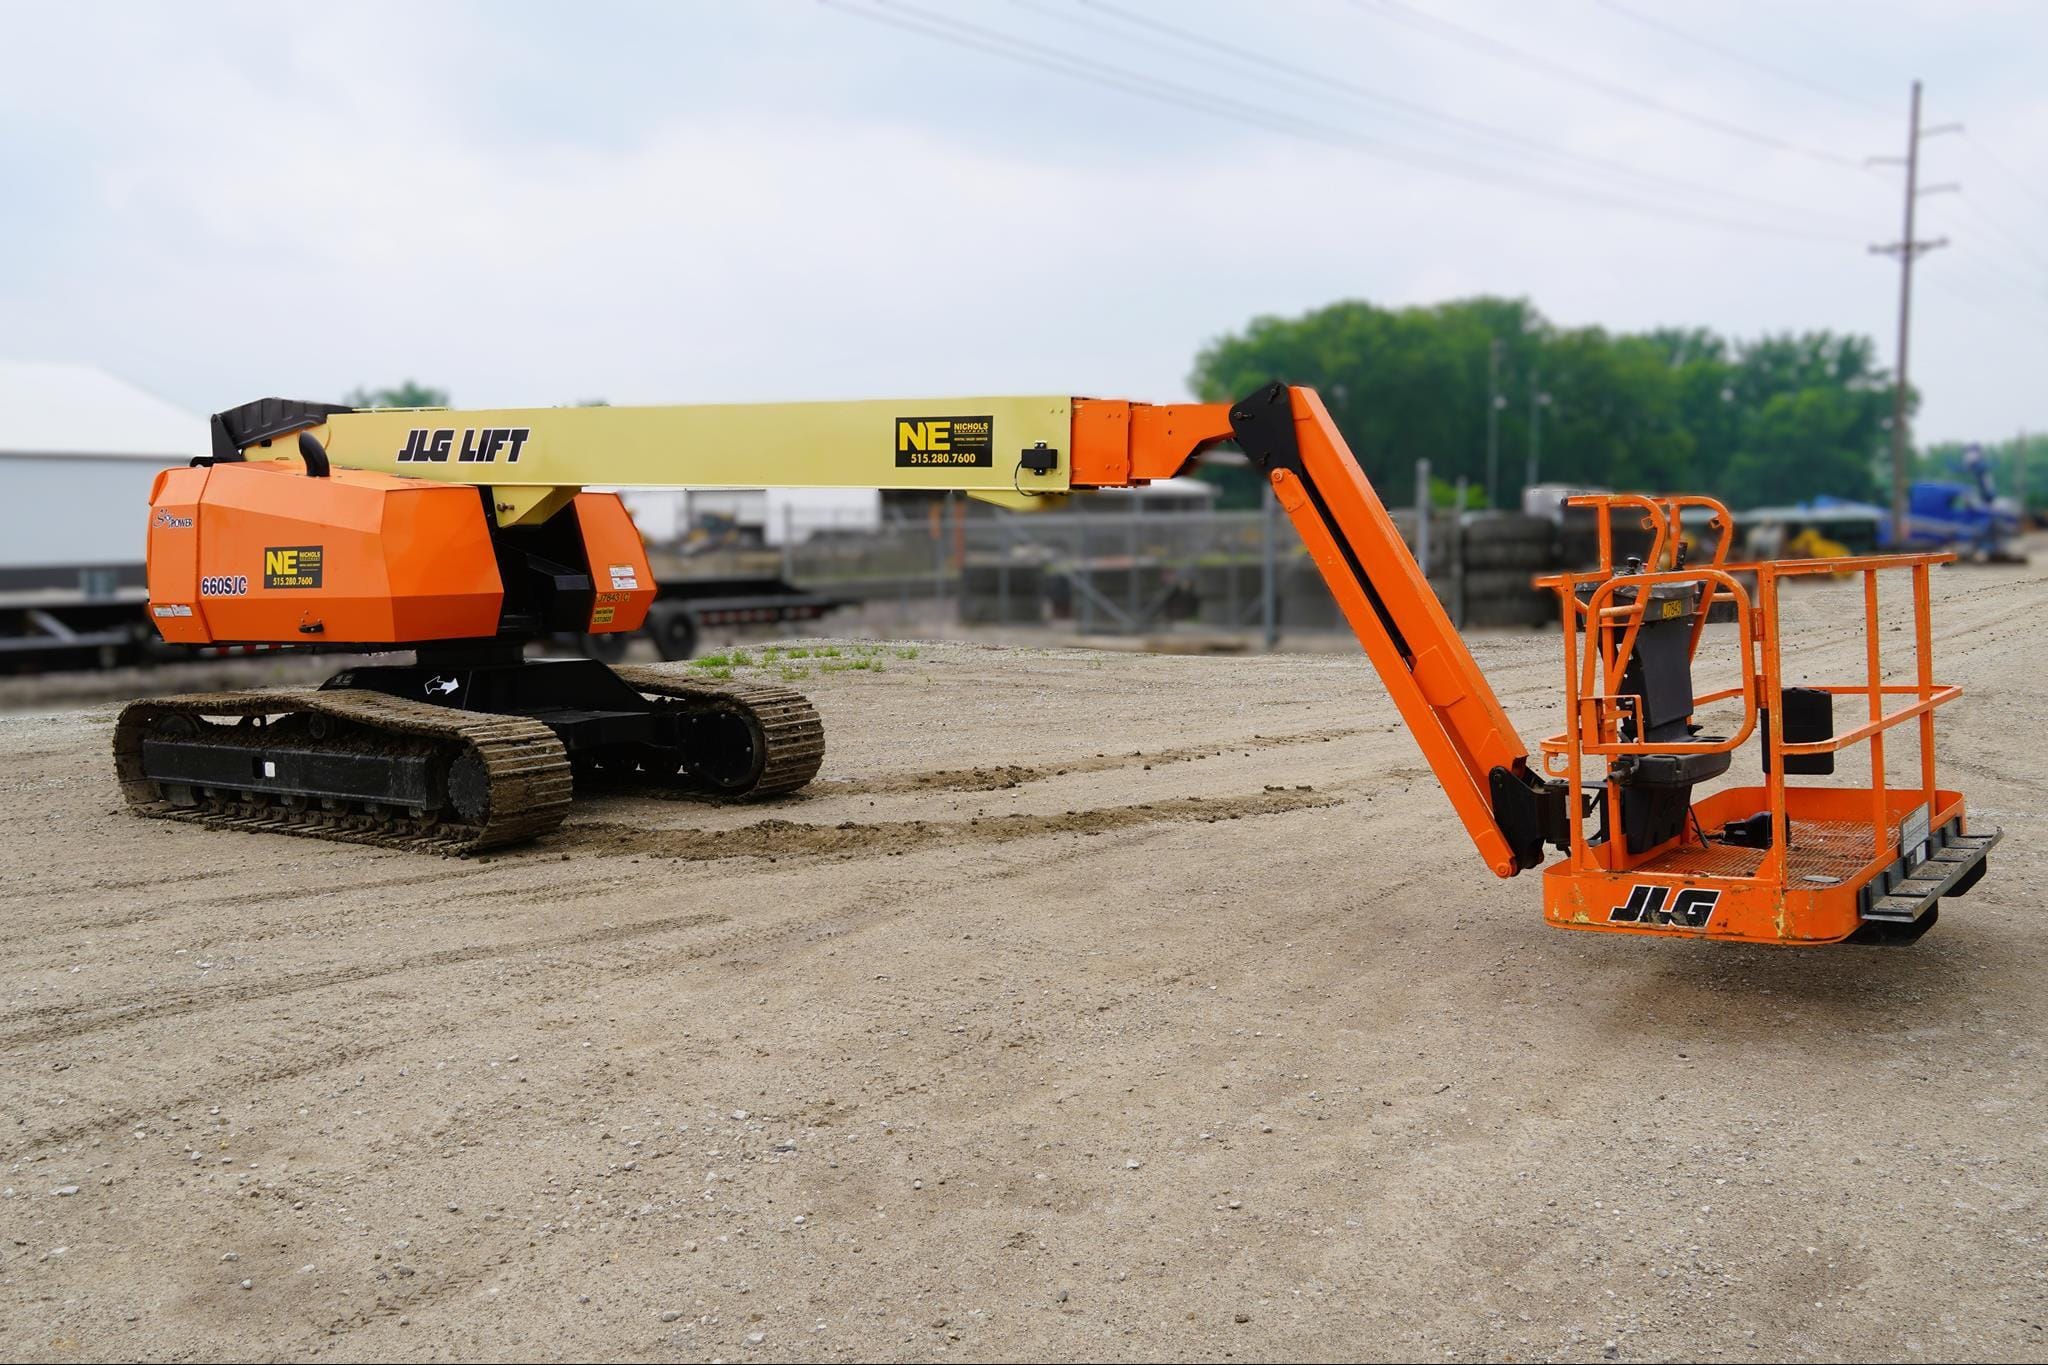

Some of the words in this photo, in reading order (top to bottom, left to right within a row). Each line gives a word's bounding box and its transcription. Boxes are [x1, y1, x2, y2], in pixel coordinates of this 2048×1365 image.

[396, 428, 455, 463] JLG
[457, 427, 530, 463] LIFT
[899, 421, 951, 451] NE
[911, 453, 976, 464] 515.280.7600
[266, 550, 298, 576] NE
[202, 576, 247, 595] 660SJC
[273, 577, 313, 585] 515.280.7600
[1608, 884, 1722, 928] JLG
